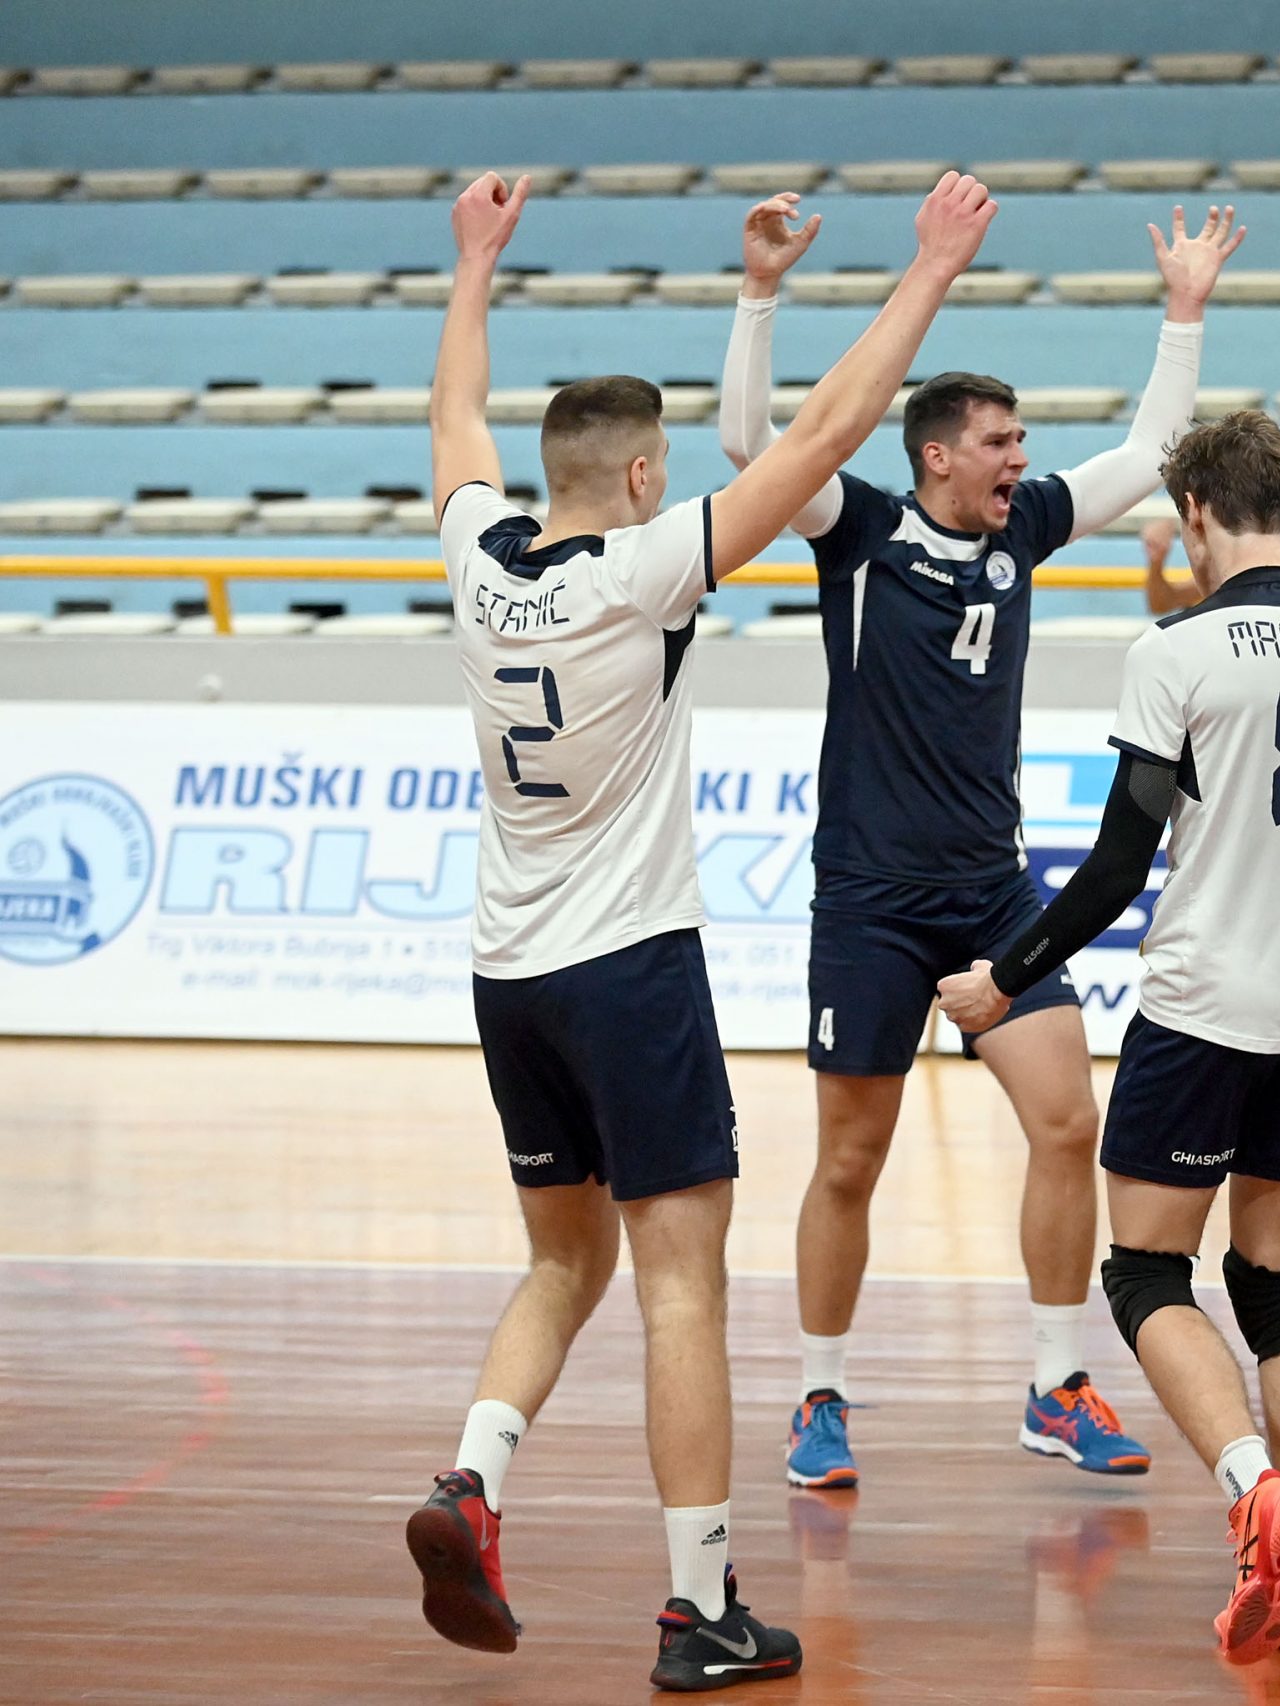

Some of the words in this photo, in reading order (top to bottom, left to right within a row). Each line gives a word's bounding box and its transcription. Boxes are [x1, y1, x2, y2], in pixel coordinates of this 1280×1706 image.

[475, 577, 570, 633] STANIĆ
[951, 603, 996, 675] 4
[494, 666, 571, 798] 2
[174, 751, 366, 809] MUŠKI
[816, 1007, 835, 1050] 4
